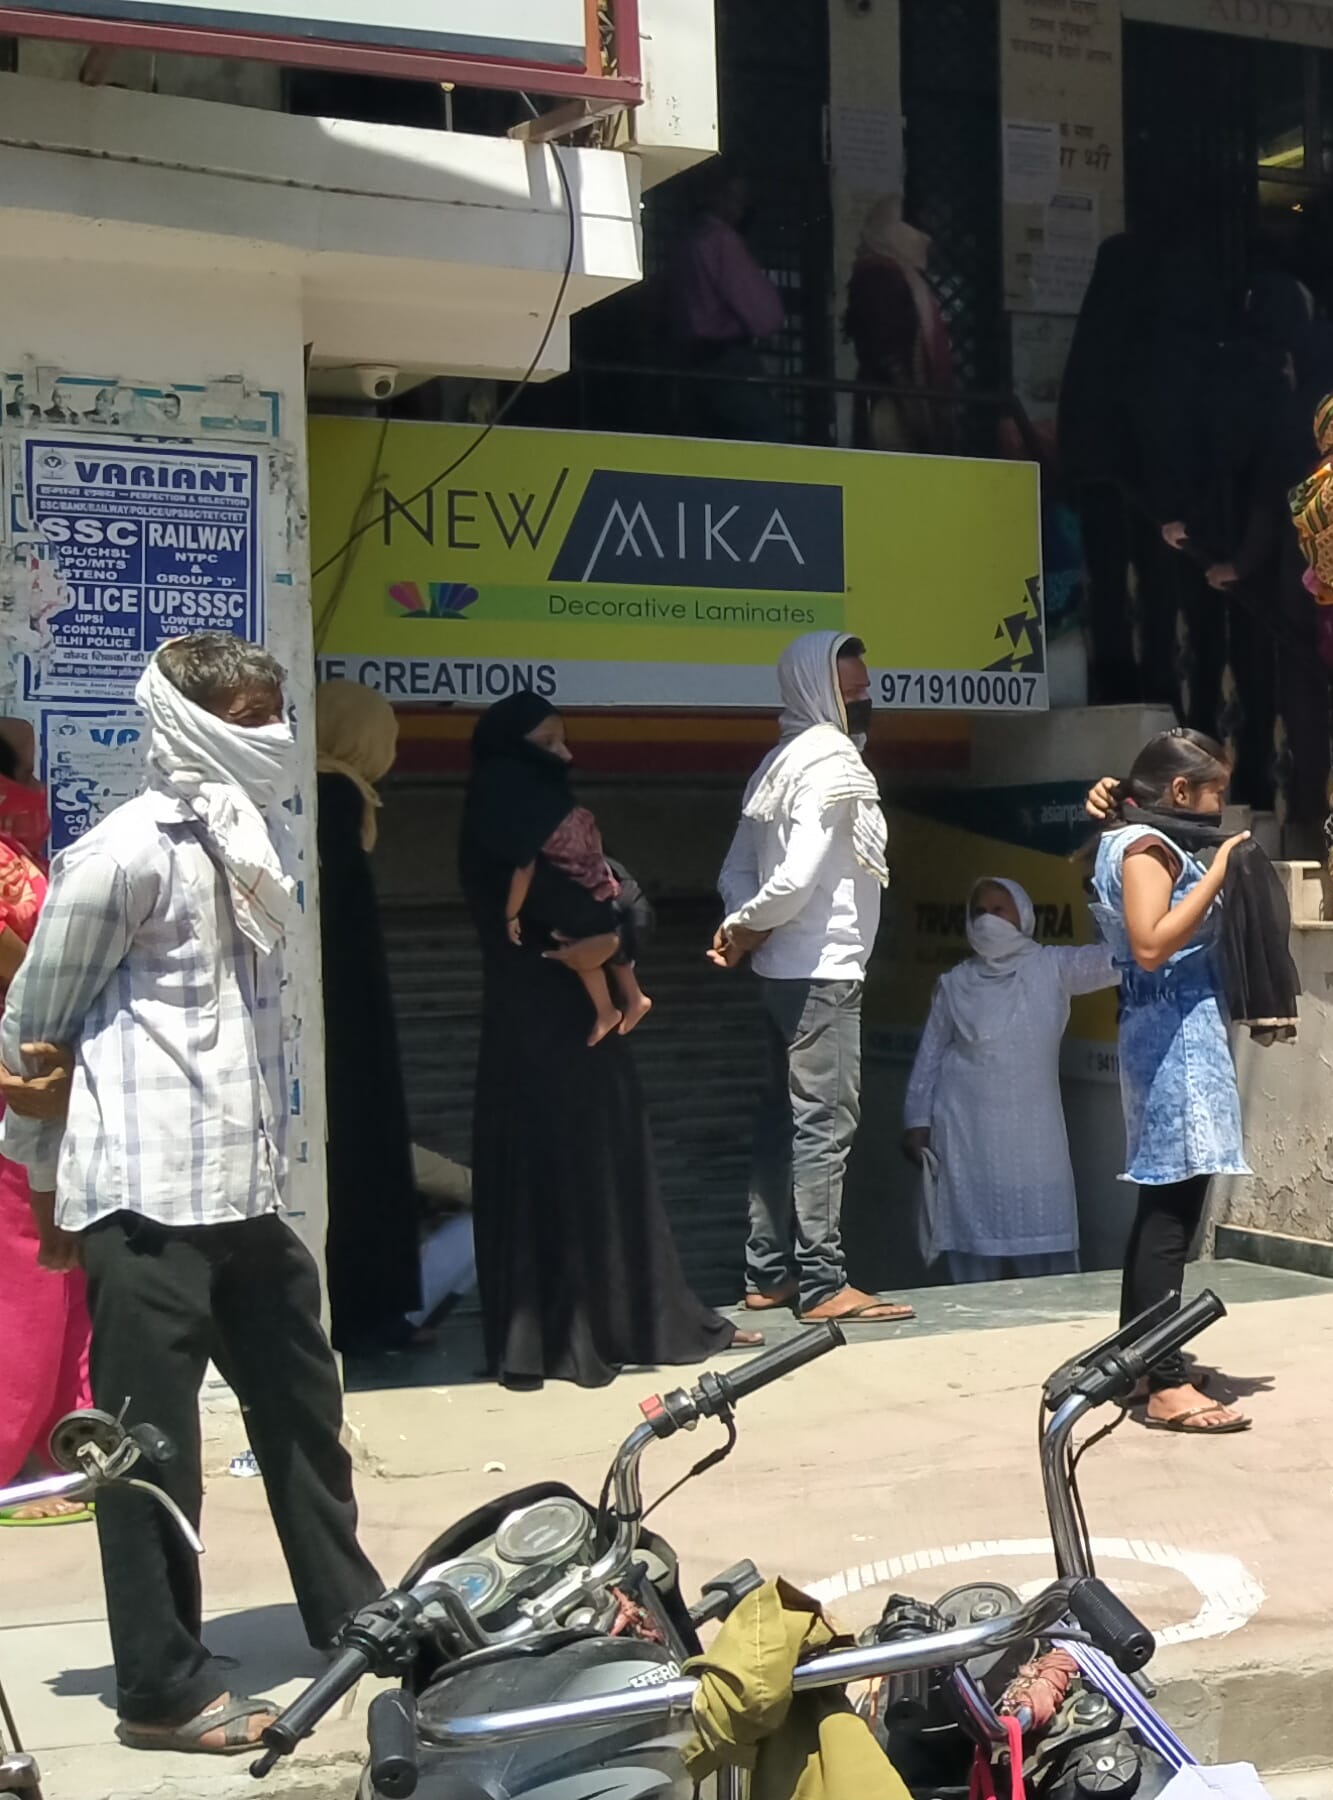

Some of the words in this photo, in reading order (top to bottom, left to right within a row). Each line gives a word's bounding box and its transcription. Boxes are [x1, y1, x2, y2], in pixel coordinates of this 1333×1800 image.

[75, 461, 248, 493] VARIANT
[382, 467, 570, 551] NEW
[41, 517, 139, 546] SSC
[149, 522, 245, 552] RAILWAY
[582, 499, 806, 582] MIKA
[57, 546, 131, 559] GL/CHSL
[59, 557, 127, 570] PO/MTS
[175, 553, 219, 564] NTPC
[156, 574, 213, 586] GROUP
[191, 564, 203, 574] &
[66, 585, 139, 613] OLICE
[148, 589, 244, 618] UPSSSC
[549, 594, 687, 621] Decorative
[695, 600, 816, 626] Laminates
[62, 624, 136, 637] CONSTABLE
[75, 613, 104, 624] UPSI
[161, 615, 205, 626] LOWER
[208, 616, 234, 628] PCS
[55, 635, 83, 646] ELHI
[87, 636, 132, 648] POLICE
[359, 660, 557, 696] CREATIONS
[880, 672, 1038, 708] 9719100007
[629, 1660, 681, 1688] HERO
